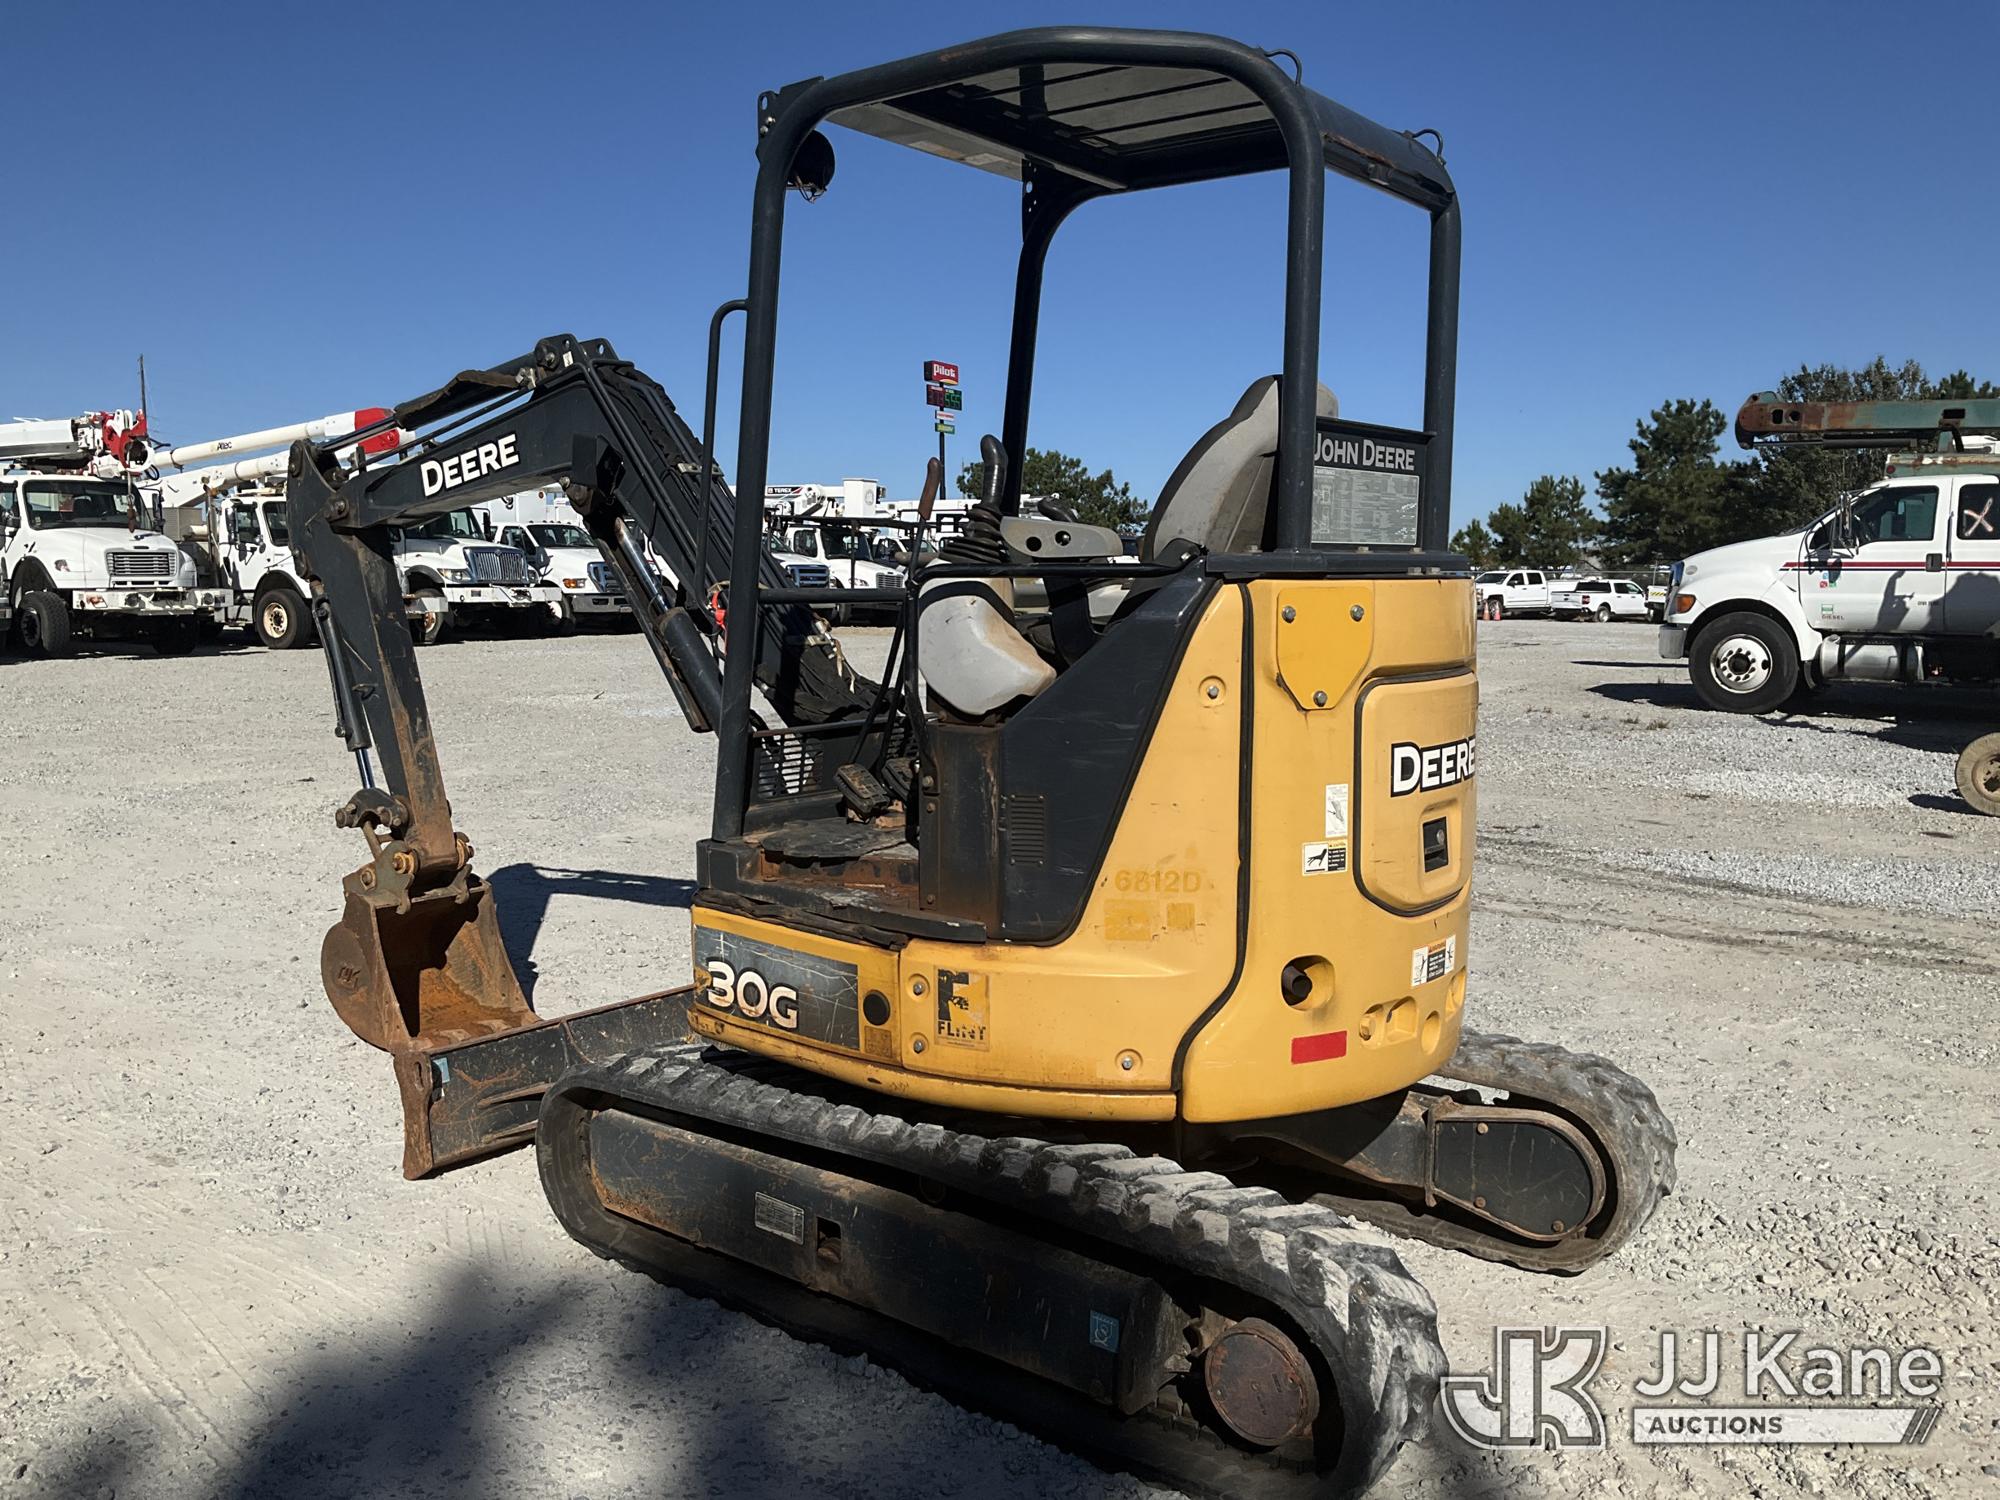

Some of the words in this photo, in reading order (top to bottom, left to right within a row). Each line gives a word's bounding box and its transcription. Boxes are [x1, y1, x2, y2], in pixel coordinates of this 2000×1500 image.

[933, 364, 956, 378] Pilot
[216, 441, 233, 451] Altec
[420, 433, 519, 496] DEERE
[1314, 433, 1358, 464] JOHN
[1363, 439, 1415, 470] DEERE
[1394, 739, 1475, 793] DEERE
[1114, 869, 1201, 893] 6812D
[707, 960, 798, 1029] 30G
